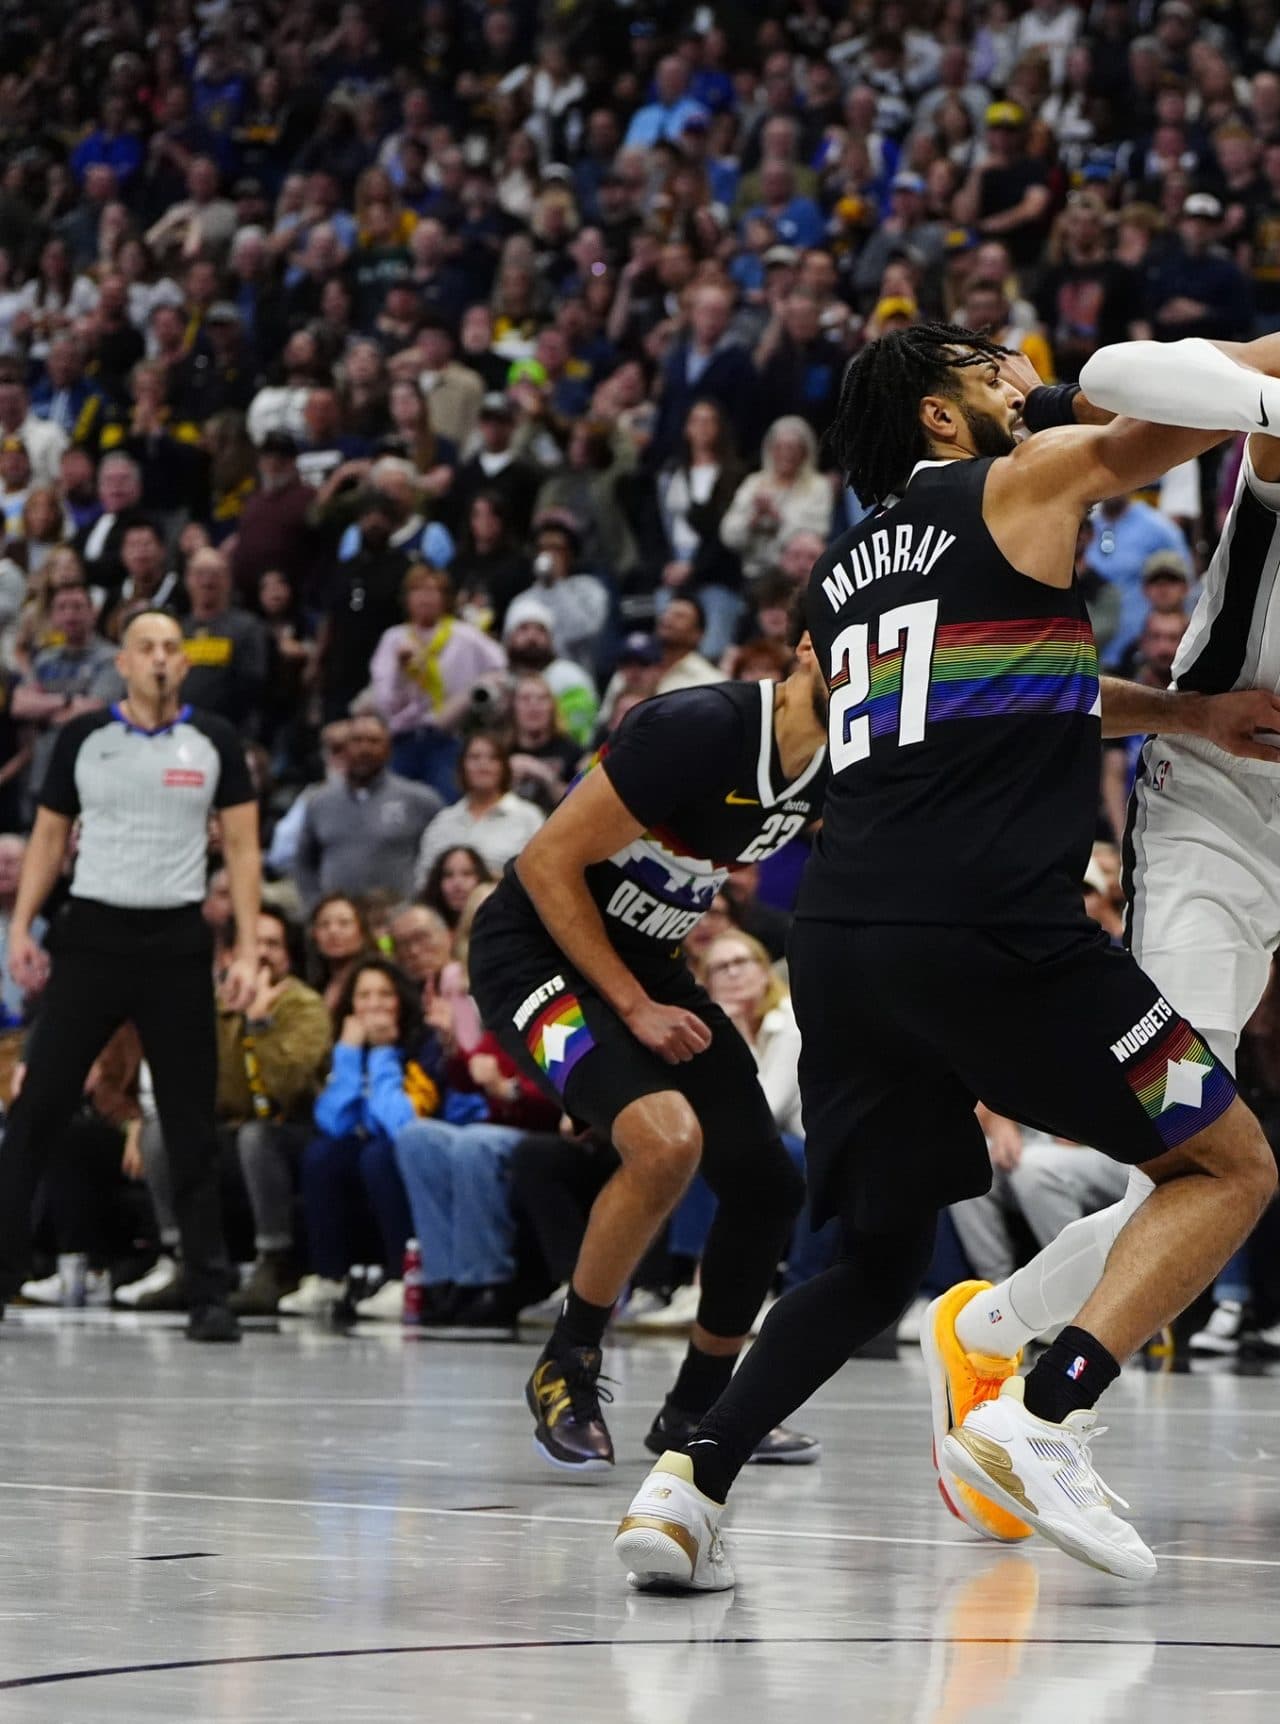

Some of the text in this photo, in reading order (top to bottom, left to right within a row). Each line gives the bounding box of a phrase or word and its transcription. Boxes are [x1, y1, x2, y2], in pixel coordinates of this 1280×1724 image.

[821, 524, 957, 614] MURRAY
[828, 599, 939, 776] 27
[736, 813, 806, 863] 23
[606, 880, 704, 940] DENVE
[512, 974, 566, 1032] NUGGETS
[1109, 997, 1173, 1063] NUGGETS
